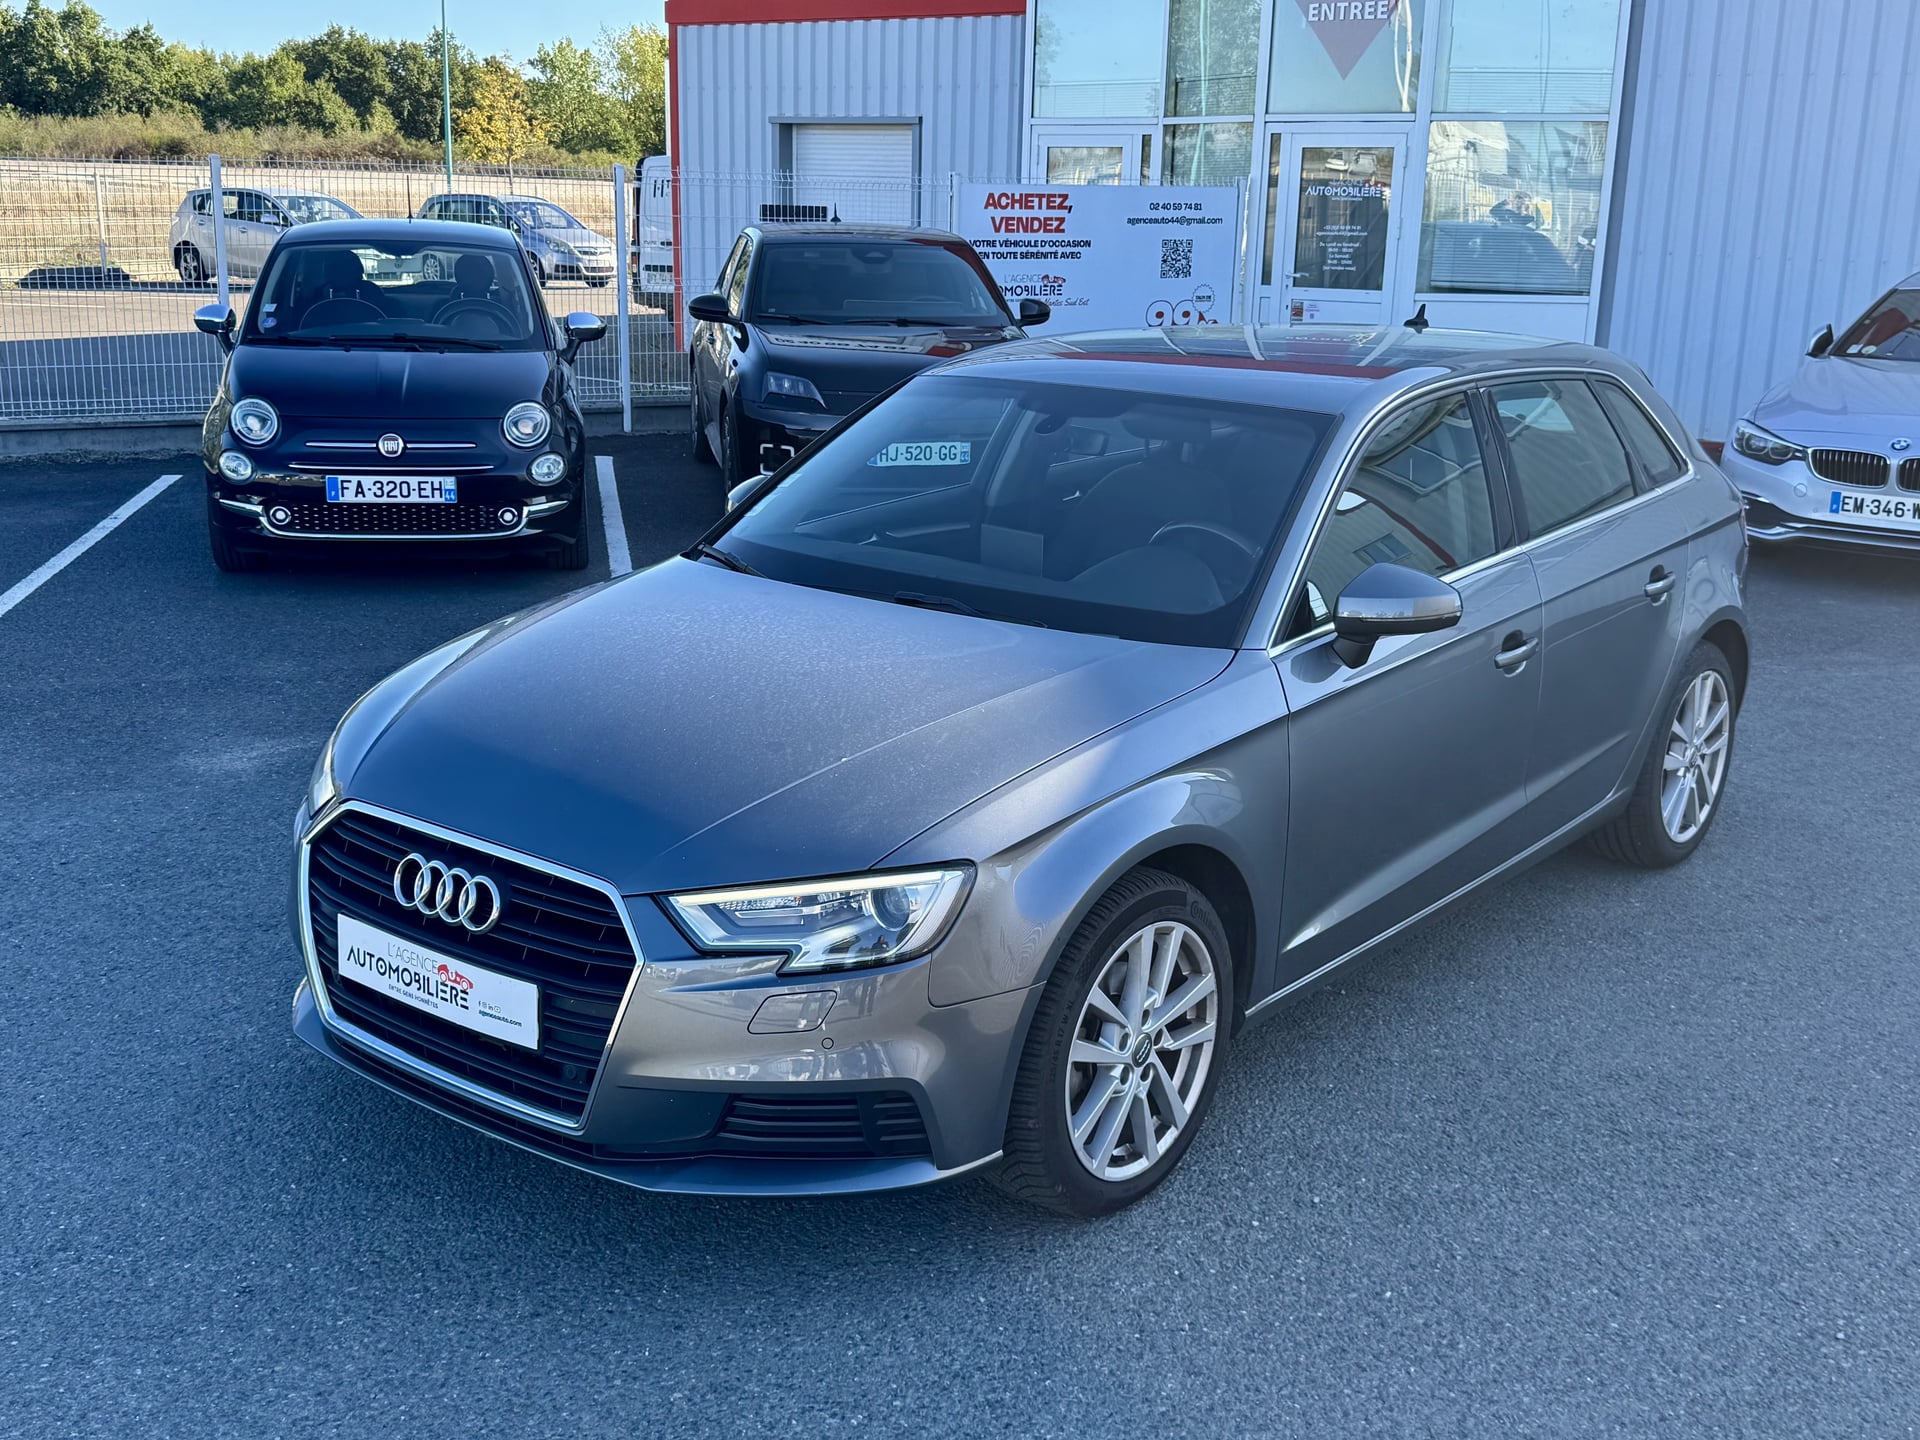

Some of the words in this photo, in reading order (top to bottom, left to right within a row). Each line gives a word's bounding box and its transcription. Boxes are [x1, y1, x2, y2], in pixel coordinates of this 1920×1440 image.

[984, 192, 1072, 213] ACHETEZ,
[990, 216, 1066, 233] VENDEZ
[1127, 216, 1223, 226] agenceauto44@gmail.com
[969, 240, 997, 248] VOTRE
[1000, 238, 1039, 248] VÉHICULE
[1040, 240, 1091, 248] D'OCCASION
[1019, 249, 1058, 259] SÉRÉNITÉ
[384, 440, 399, 452] FIAT
[879, 445, 957, 462] HJ-520-GG
[340, 480, 443, 499] FA-320-EH
[387, 941, 438, 974] L'AGENCE
